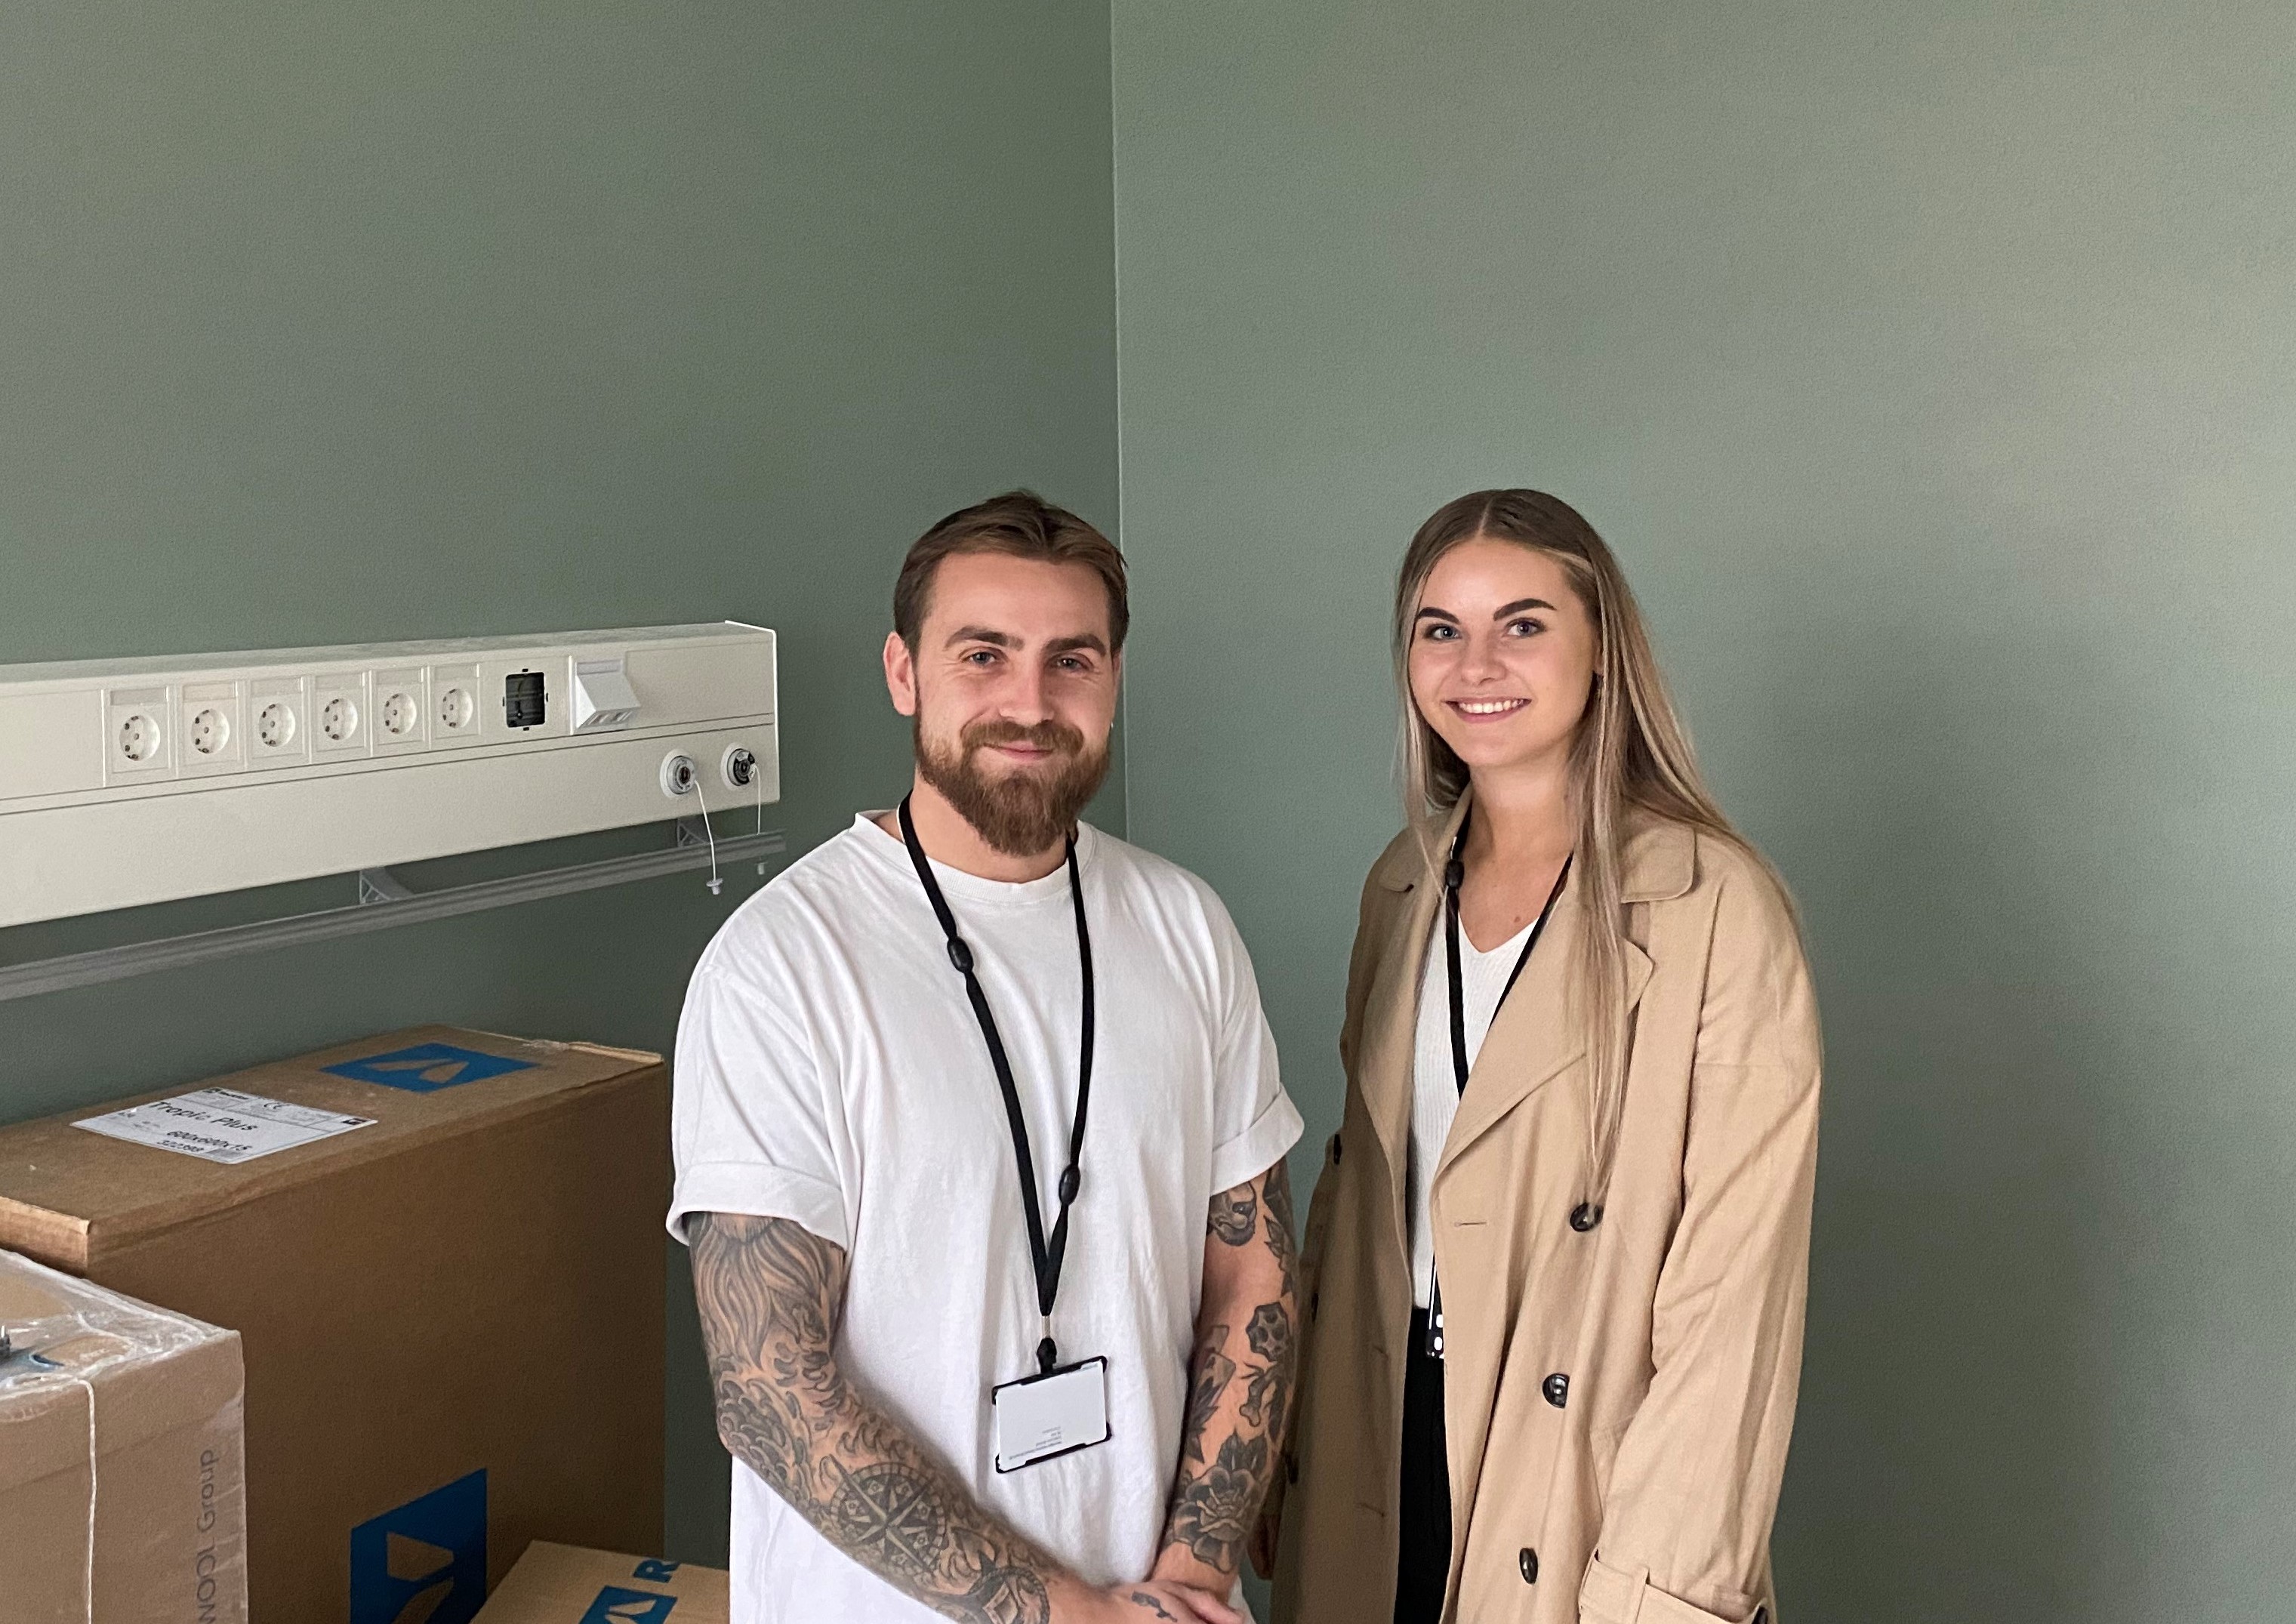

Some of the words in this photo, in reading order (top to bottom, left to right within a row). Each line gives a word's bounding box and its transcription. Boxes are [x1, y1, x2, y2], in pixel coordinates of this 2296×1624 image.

[149, 1102, 211, 1120] Tropic
[210, 1117, 257, 1130] Plus
[196, 1450, 220, 1533] Group
